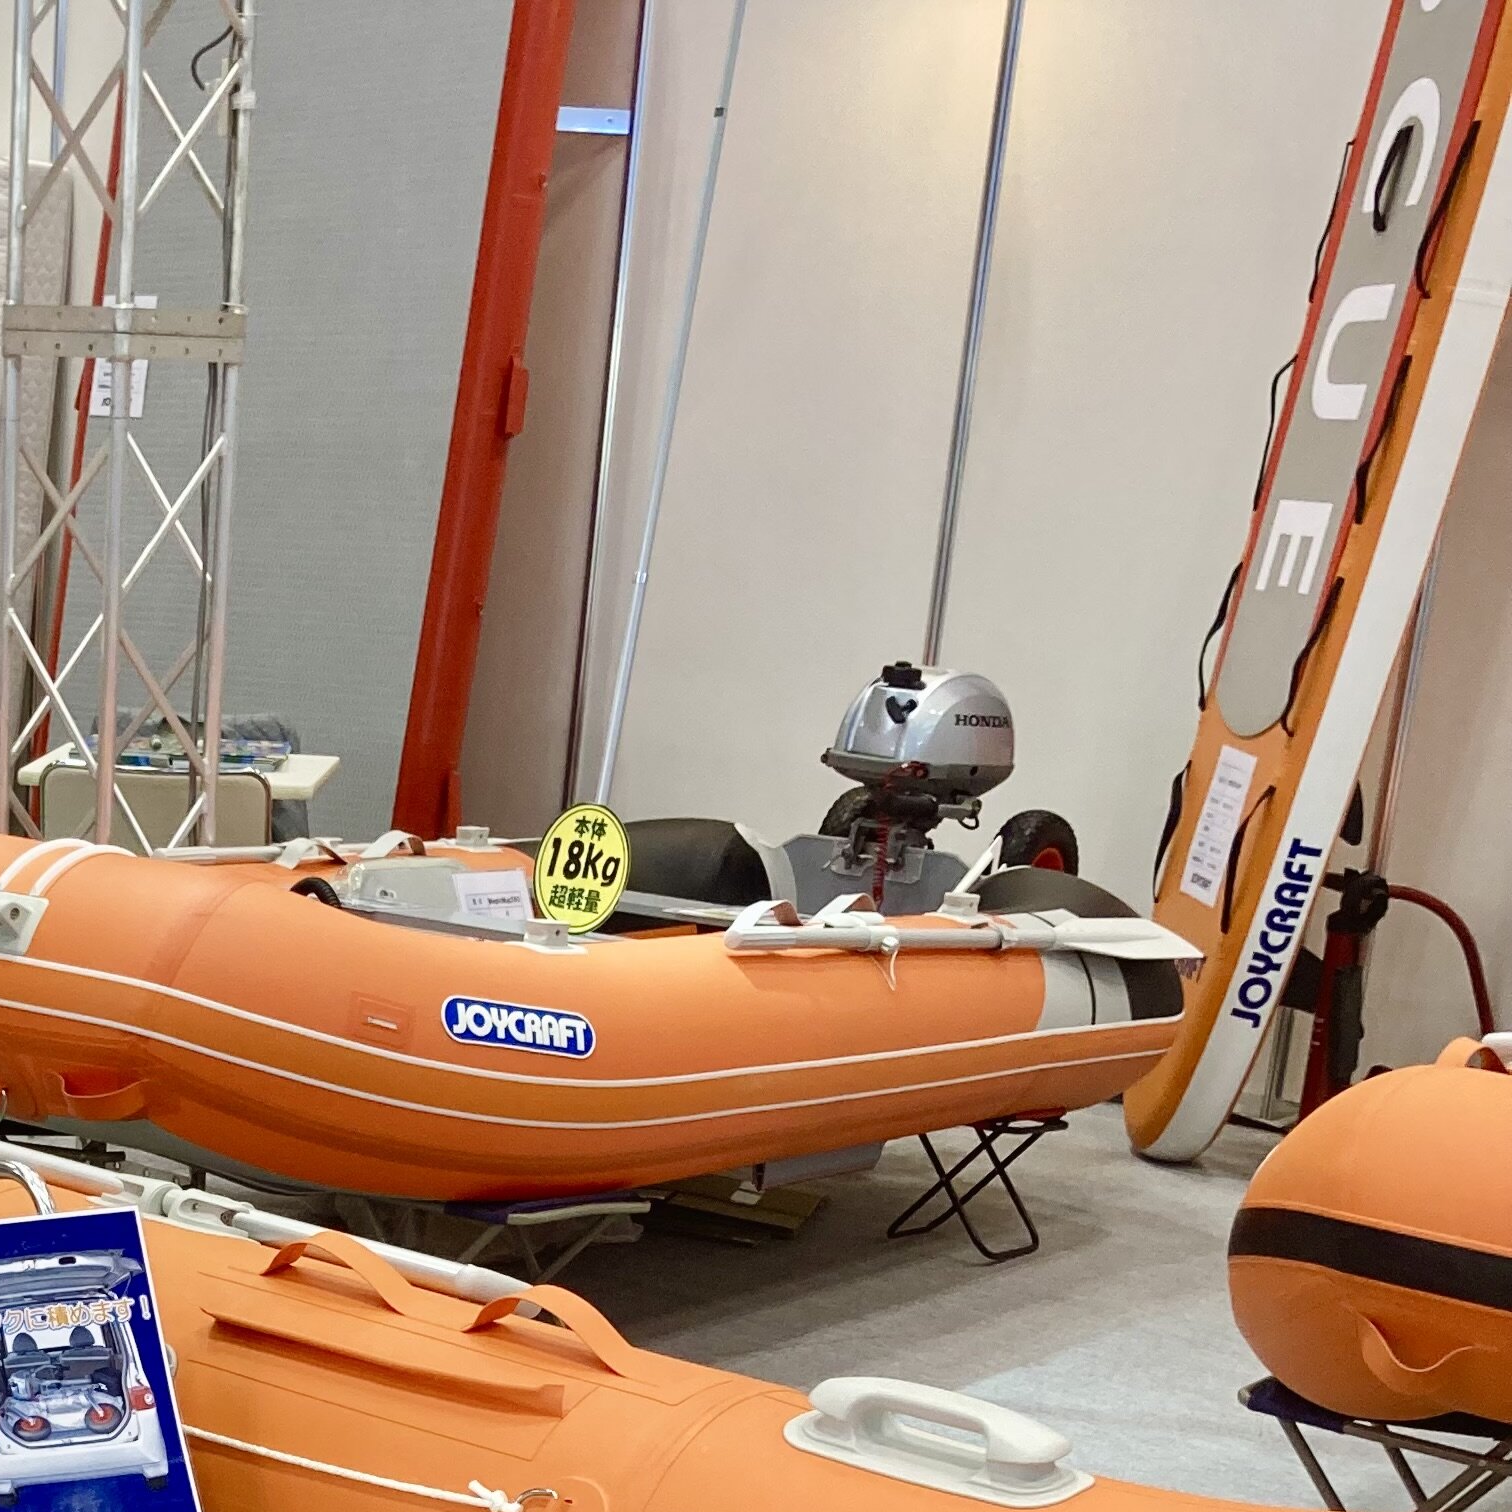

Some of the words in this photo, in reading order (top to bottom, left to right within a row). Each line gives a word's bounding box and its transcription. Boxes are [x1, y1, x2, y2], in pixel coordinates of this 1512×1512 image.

[1255, 0, 1442, 595] CUE
[954, 714, 1010, 729] HONDA
[574, 816, 608, 841] 本体
[548, 884, 601, 914] 超軽量
[1230, 837, 1323, 1029] JOYCRAFT
[453, 1002, 586, 1051] JOYCRAFT
